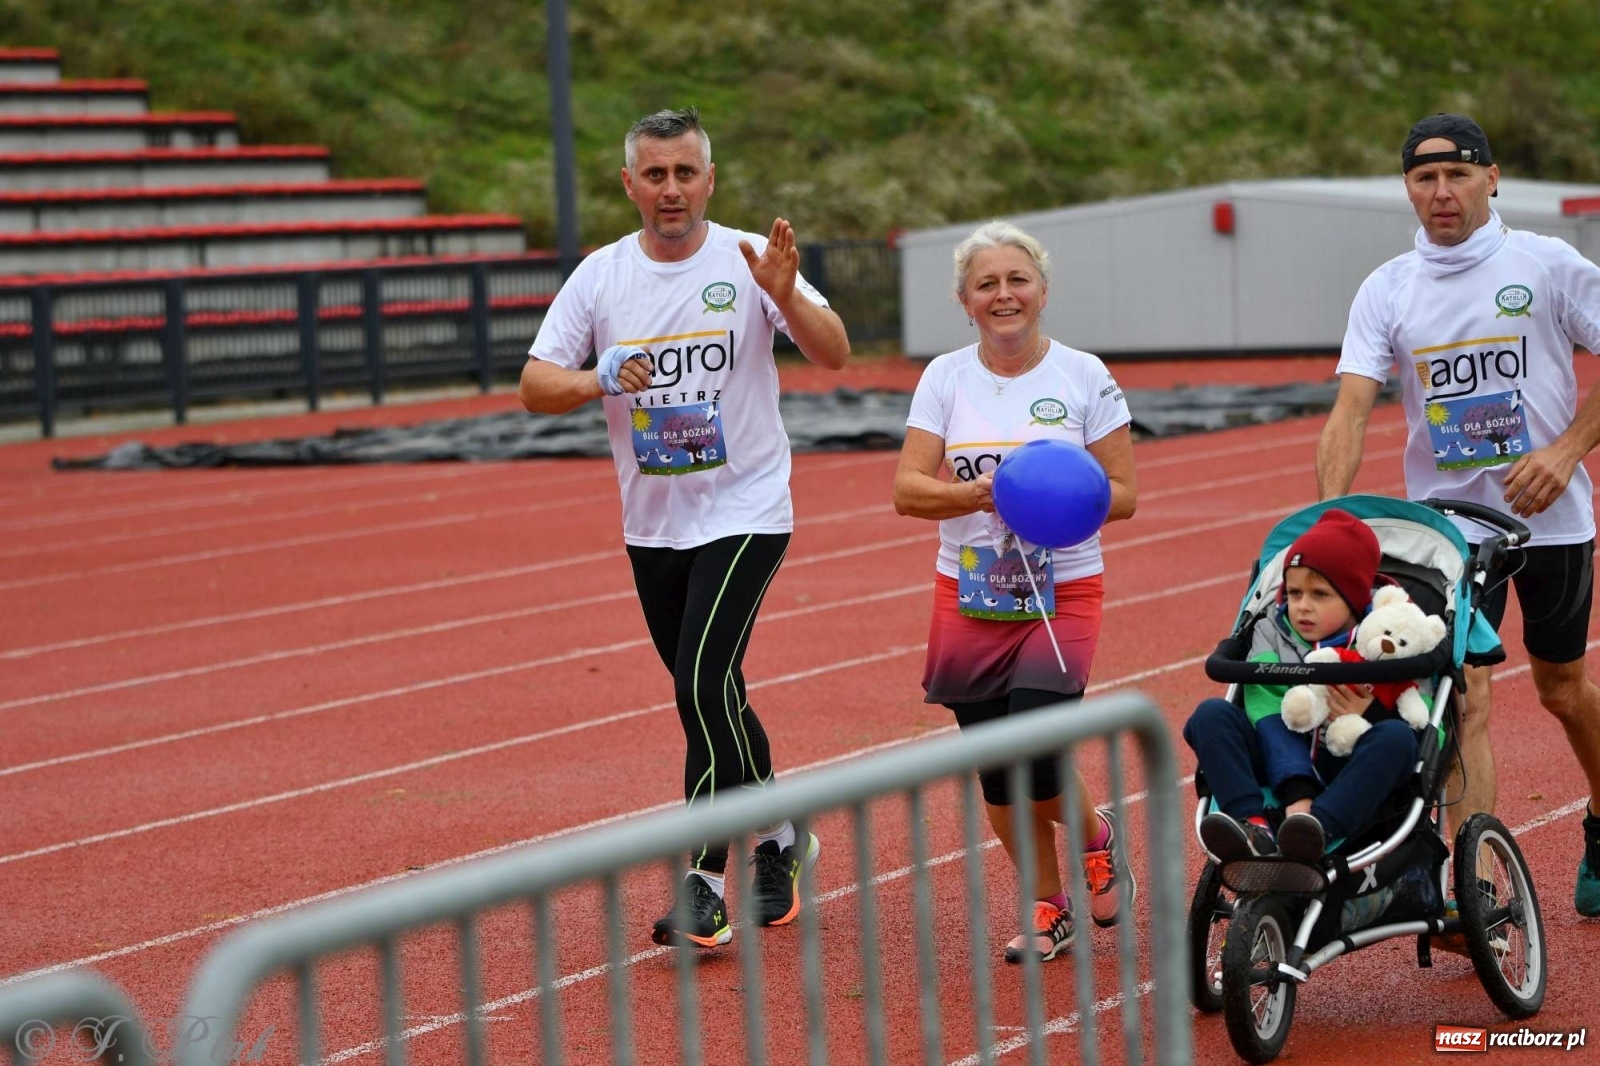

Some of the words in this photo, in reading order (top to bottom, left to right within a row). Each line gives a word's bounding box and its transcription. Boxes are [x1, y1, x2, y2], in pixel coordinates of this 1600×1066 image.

[1425, 335, 1527, 402] agrol
[635, 389, 721, 407] KIETRZ
[1440, 423, 1460, 434] BIEG
[1464, 421, 1481, 432] DLA
[642, 431, 659, 440] BIEG
[663, 431, 678, 440] DLA
[1492, 439, 1523, 455] 135
[686, 448, 719, 464] 142
[968, 572, 986, 582] BIEG
[990, 574, 1007, 583] DLA
[1254, 662, 1316, 675] X-lander
